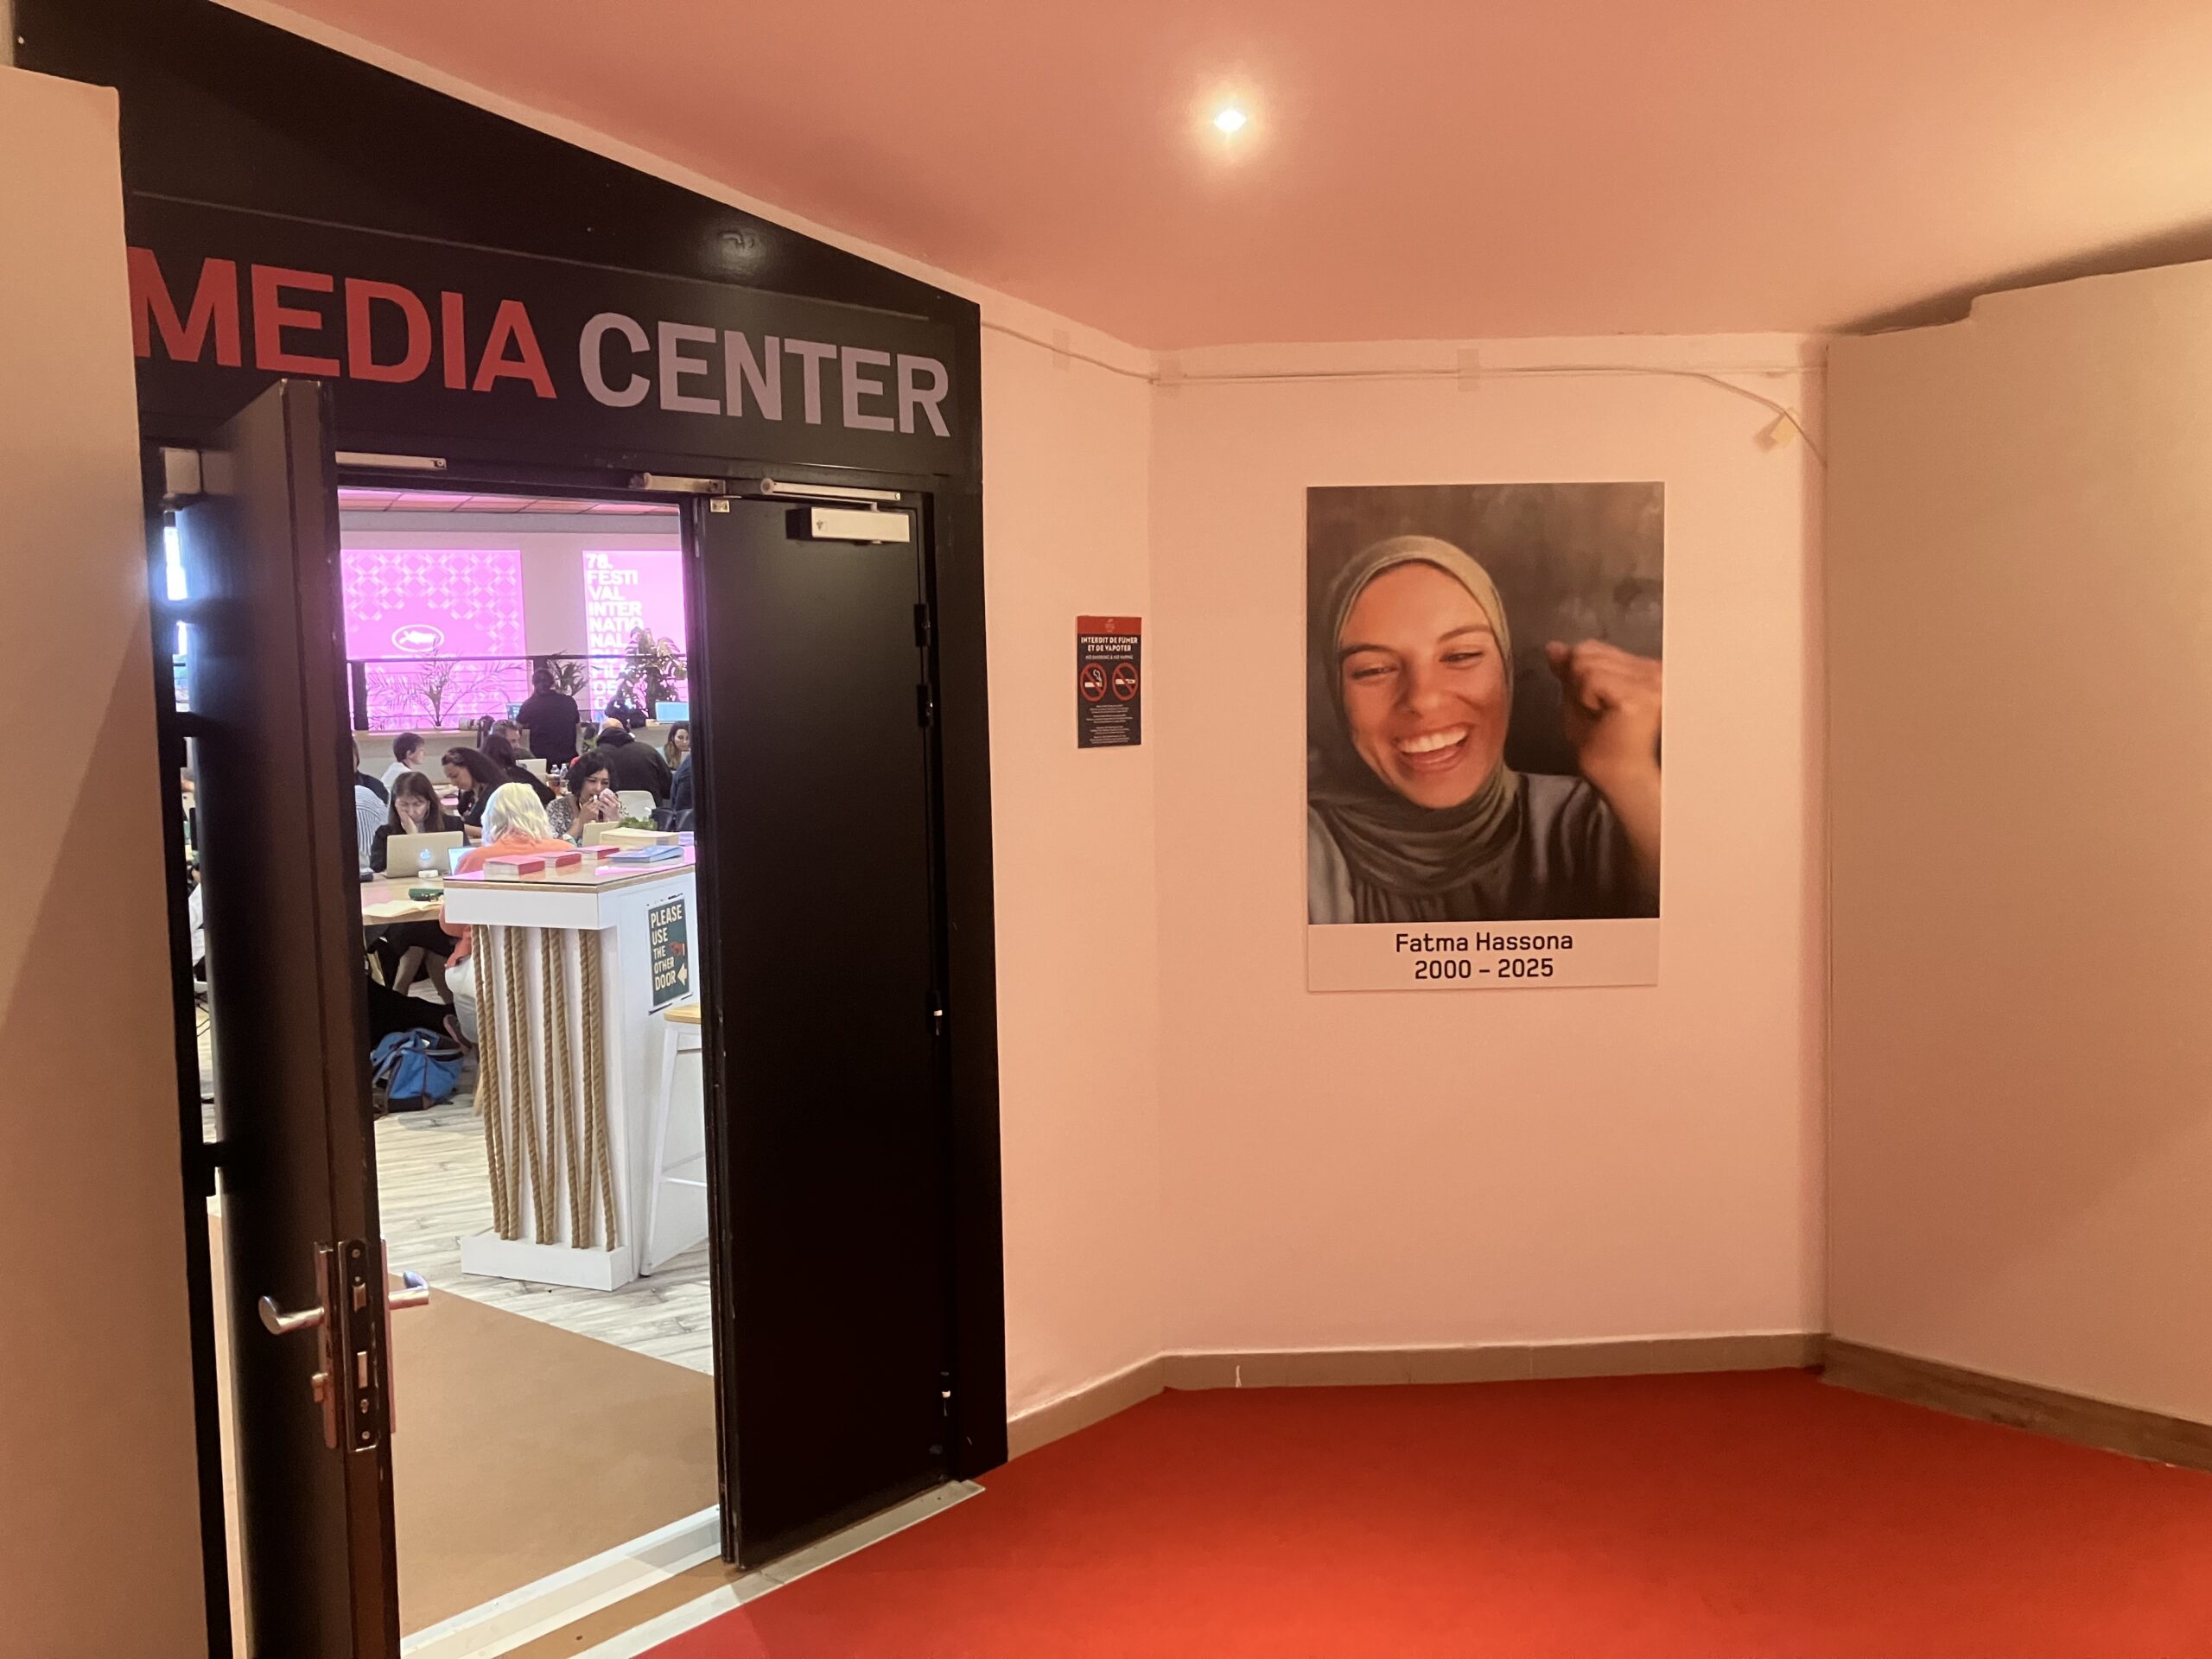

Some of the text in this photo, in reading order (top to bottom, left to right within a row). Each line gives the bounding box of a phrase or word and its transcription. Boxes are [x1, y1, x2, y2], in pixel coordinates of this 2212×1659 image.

[127, 247, 951, 439] MEDIA CENTER
[587, 569, 639, 586] FESTI
[588, 586, 625, 601] VAL
[588, 601, 643, 617] INTER
[590, 617, 644, 632] NATIO
[590, 632, 627, 648] NAL
[651, 904, 683, 929] PLEASE
[652, 927, 669, 945] USE
[1395, 931, 1573, 953] Fatma Hassona
[653, 945, 666, 959] THE
[654, 957, 675, 974] OTHER
[1414, 959, 1472, 979] 2000
[1497, 957, 1554, 978] 2025
[655, 970, 677, 991] DOOR
